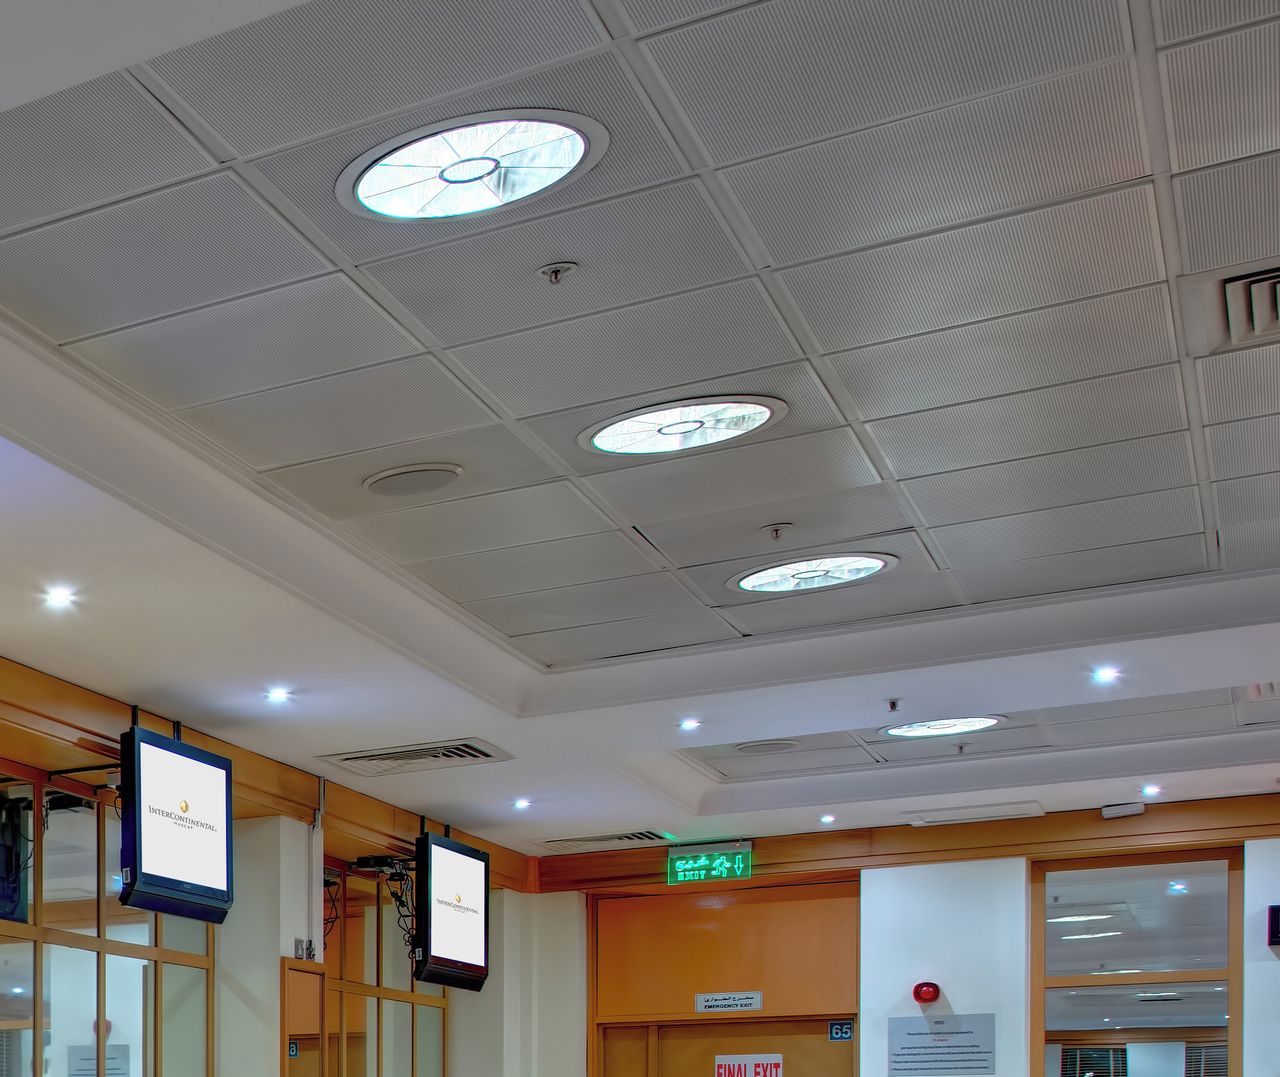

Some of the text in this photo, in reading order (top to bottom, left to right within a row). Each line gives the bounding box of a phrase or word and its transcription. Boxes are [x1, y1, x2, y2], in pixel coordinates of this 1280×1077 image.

[677, 870, 706, 881] EXIT
[704, 1002, 739, 1010] EMERGENCY
[832, 1024, 851, 1039] 65
